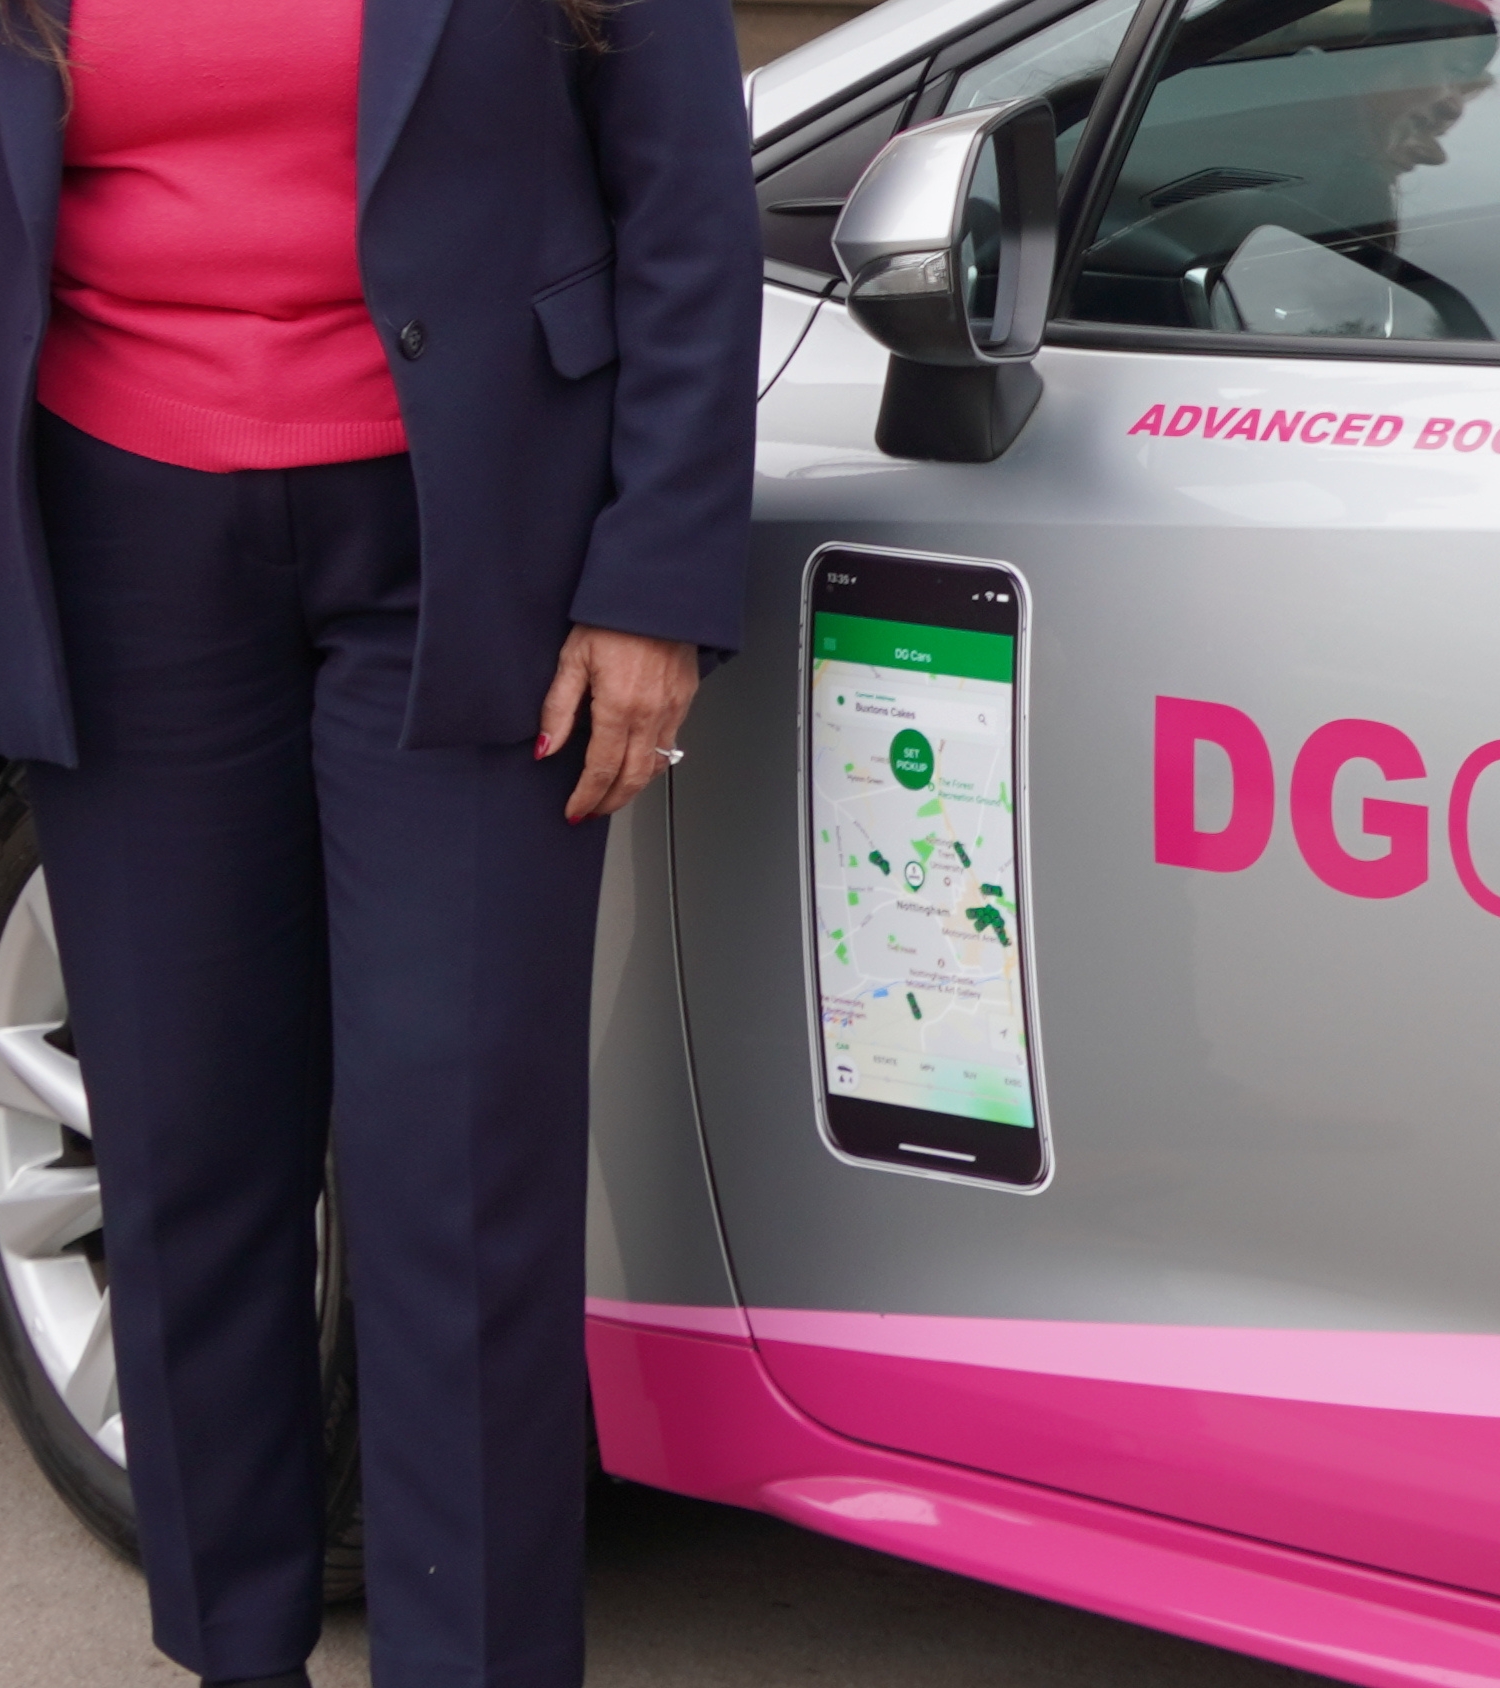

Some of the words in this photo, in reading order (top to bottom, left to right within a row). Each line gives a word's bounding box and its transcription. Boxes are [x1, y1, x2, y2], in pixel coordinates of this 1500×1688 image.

[1127, 403, 1402, 449] ADVANCED
[910, 650, 932, 663] Cars
[856, 703, 888, 716] Buxtons
[891, 707, 915, 720] Cakes
[903, 747, 920, 759] SET
[896, 759, 928, 772] PICKUP
[896, 900, 950, 917] Nottingham
